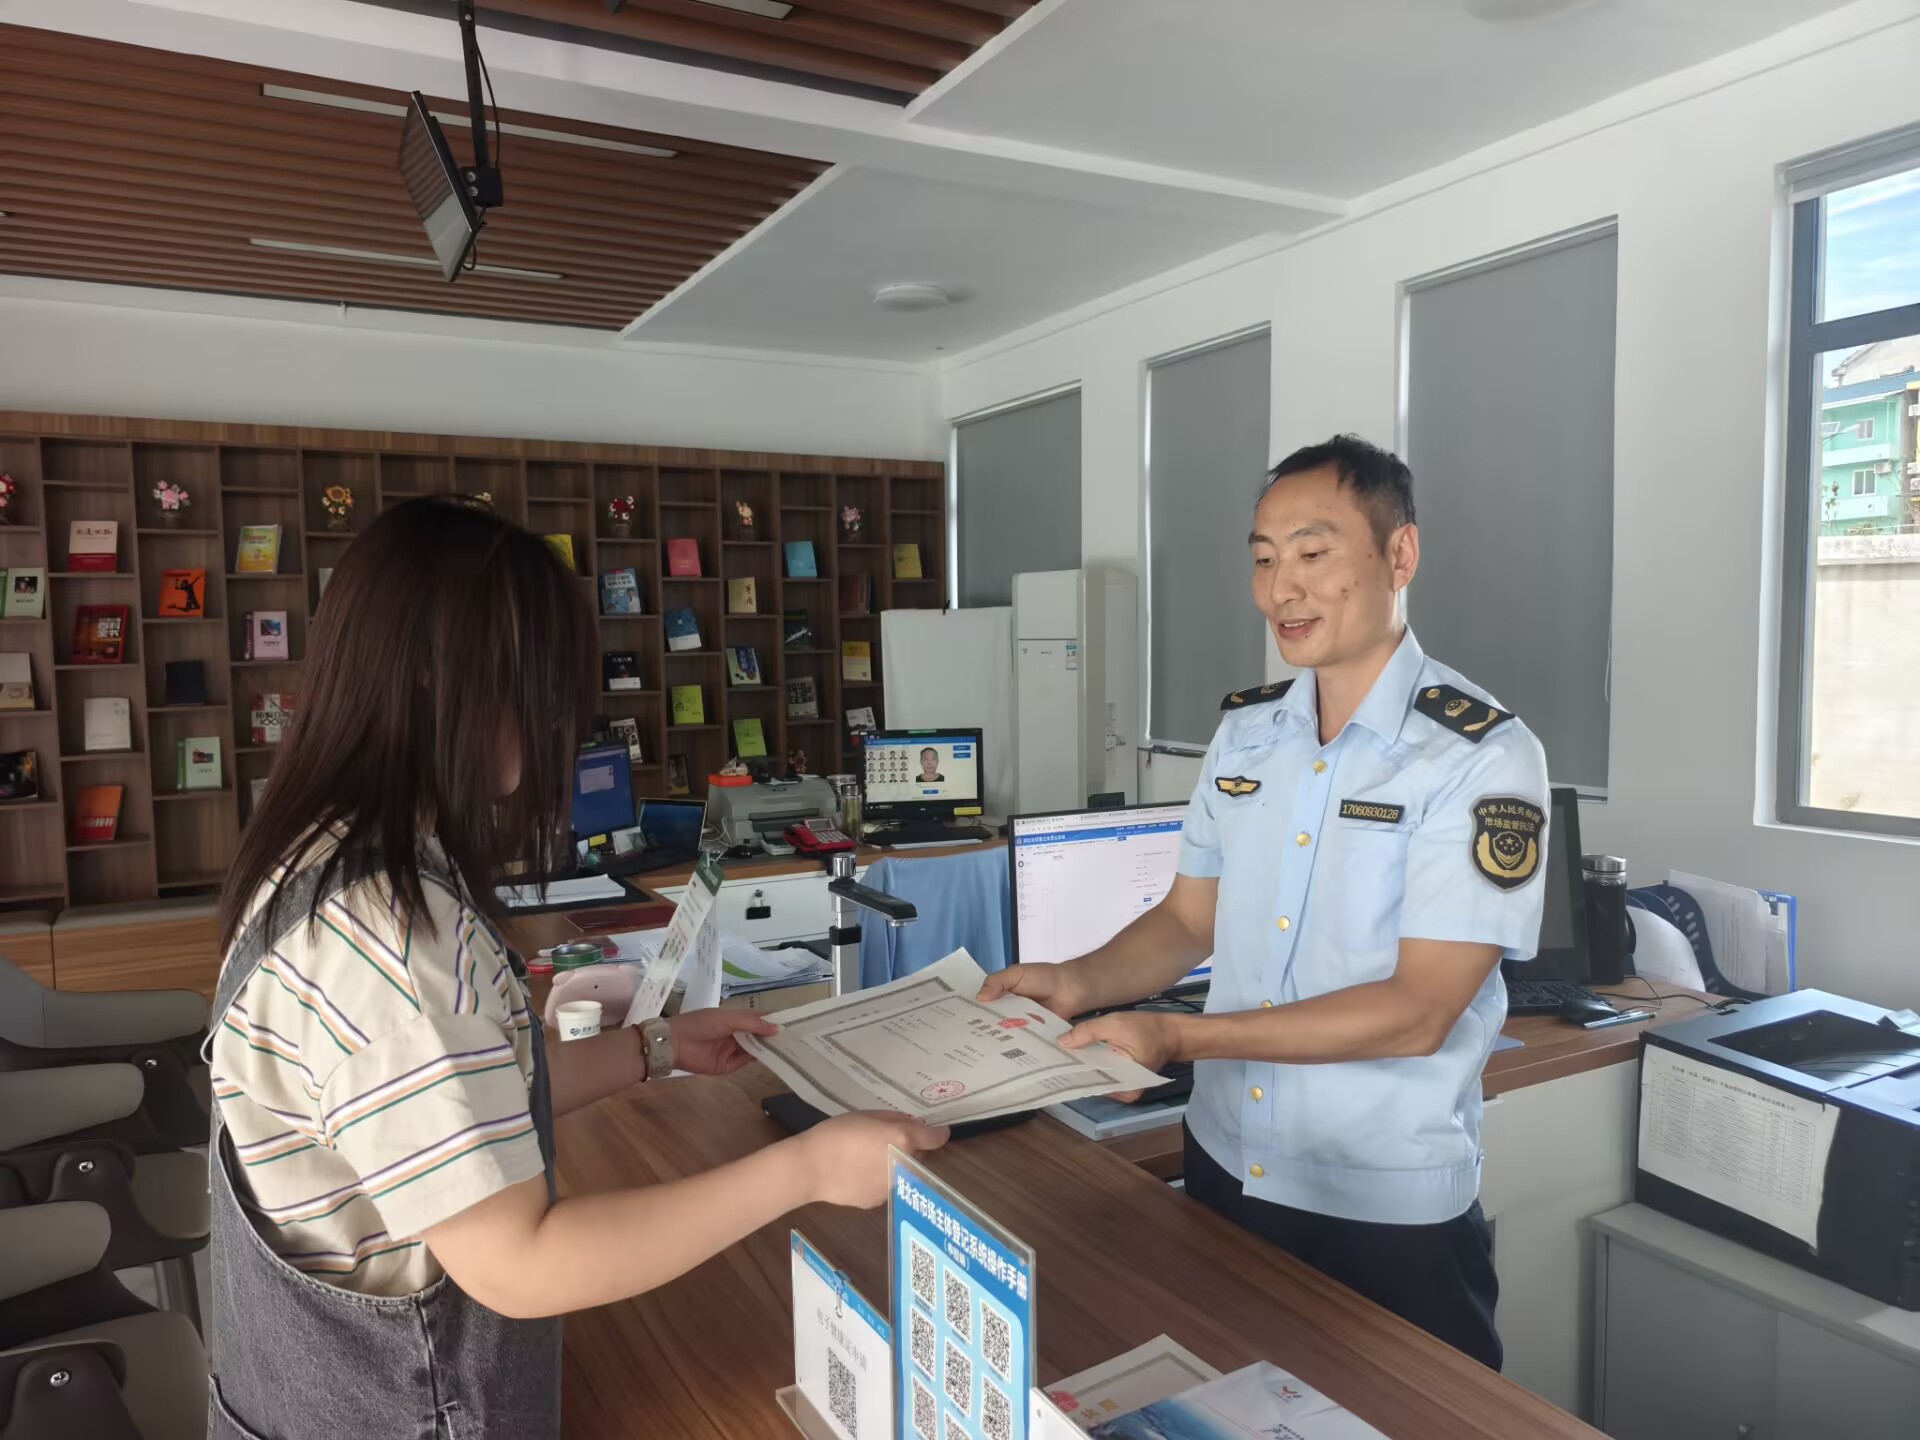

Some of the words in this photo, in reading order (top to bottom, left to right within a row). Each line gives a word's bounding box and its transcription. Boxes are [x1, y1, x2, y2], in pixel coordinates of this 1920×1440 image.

[1342, 804, 1399, 819] 17060930128
[1478, 804, 1541, 824] 中华人民共和国
[1484, 817, 1536, 832] 市场监管执法
[897, 1175, 1028, 1301] 湖北省市场主体登记系统操作手册
